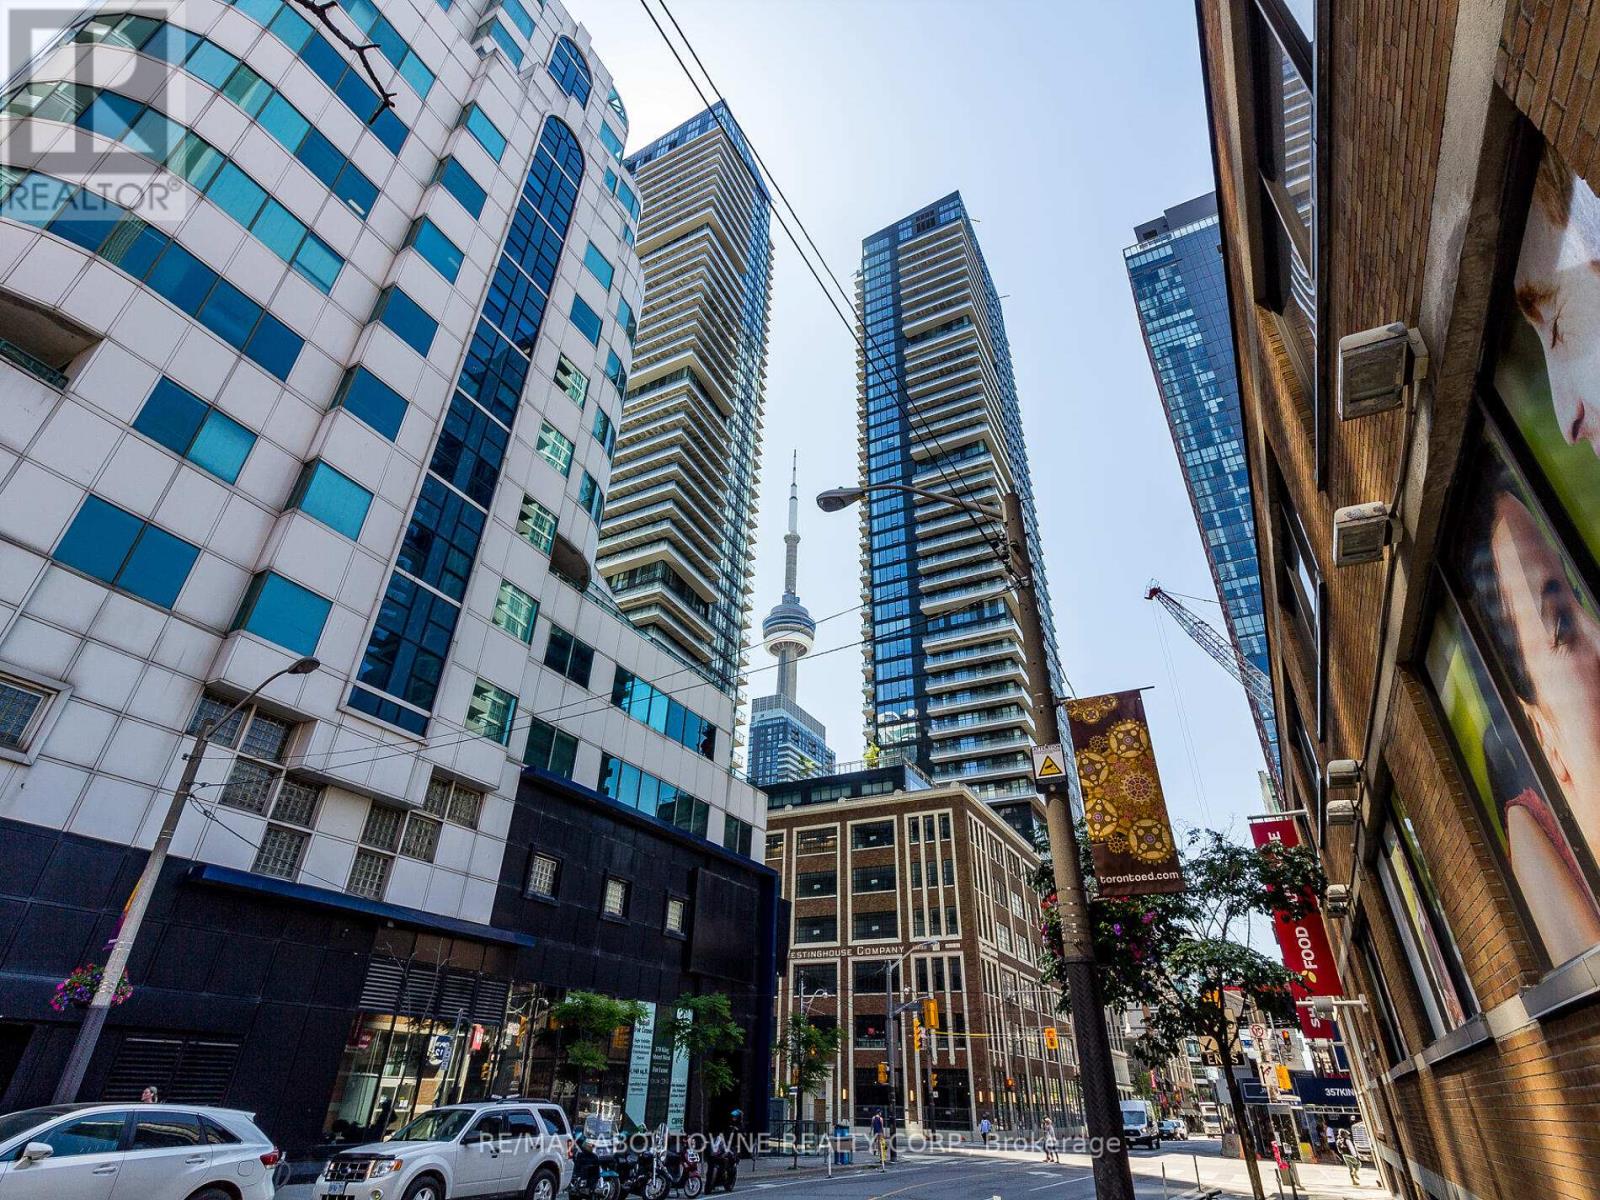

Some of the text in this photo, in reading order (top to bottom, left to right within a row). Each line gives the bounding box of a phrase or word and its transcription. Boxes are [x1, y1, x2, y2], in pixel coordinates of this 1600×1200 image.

[1100, 872, 1179, 884] torontoed.com
[788, 949, 852, 959] ESTINGHOUSE
[1295, 926, 1318, 970] FOOD
[1207, 1053, 1239, 1065] ENS
